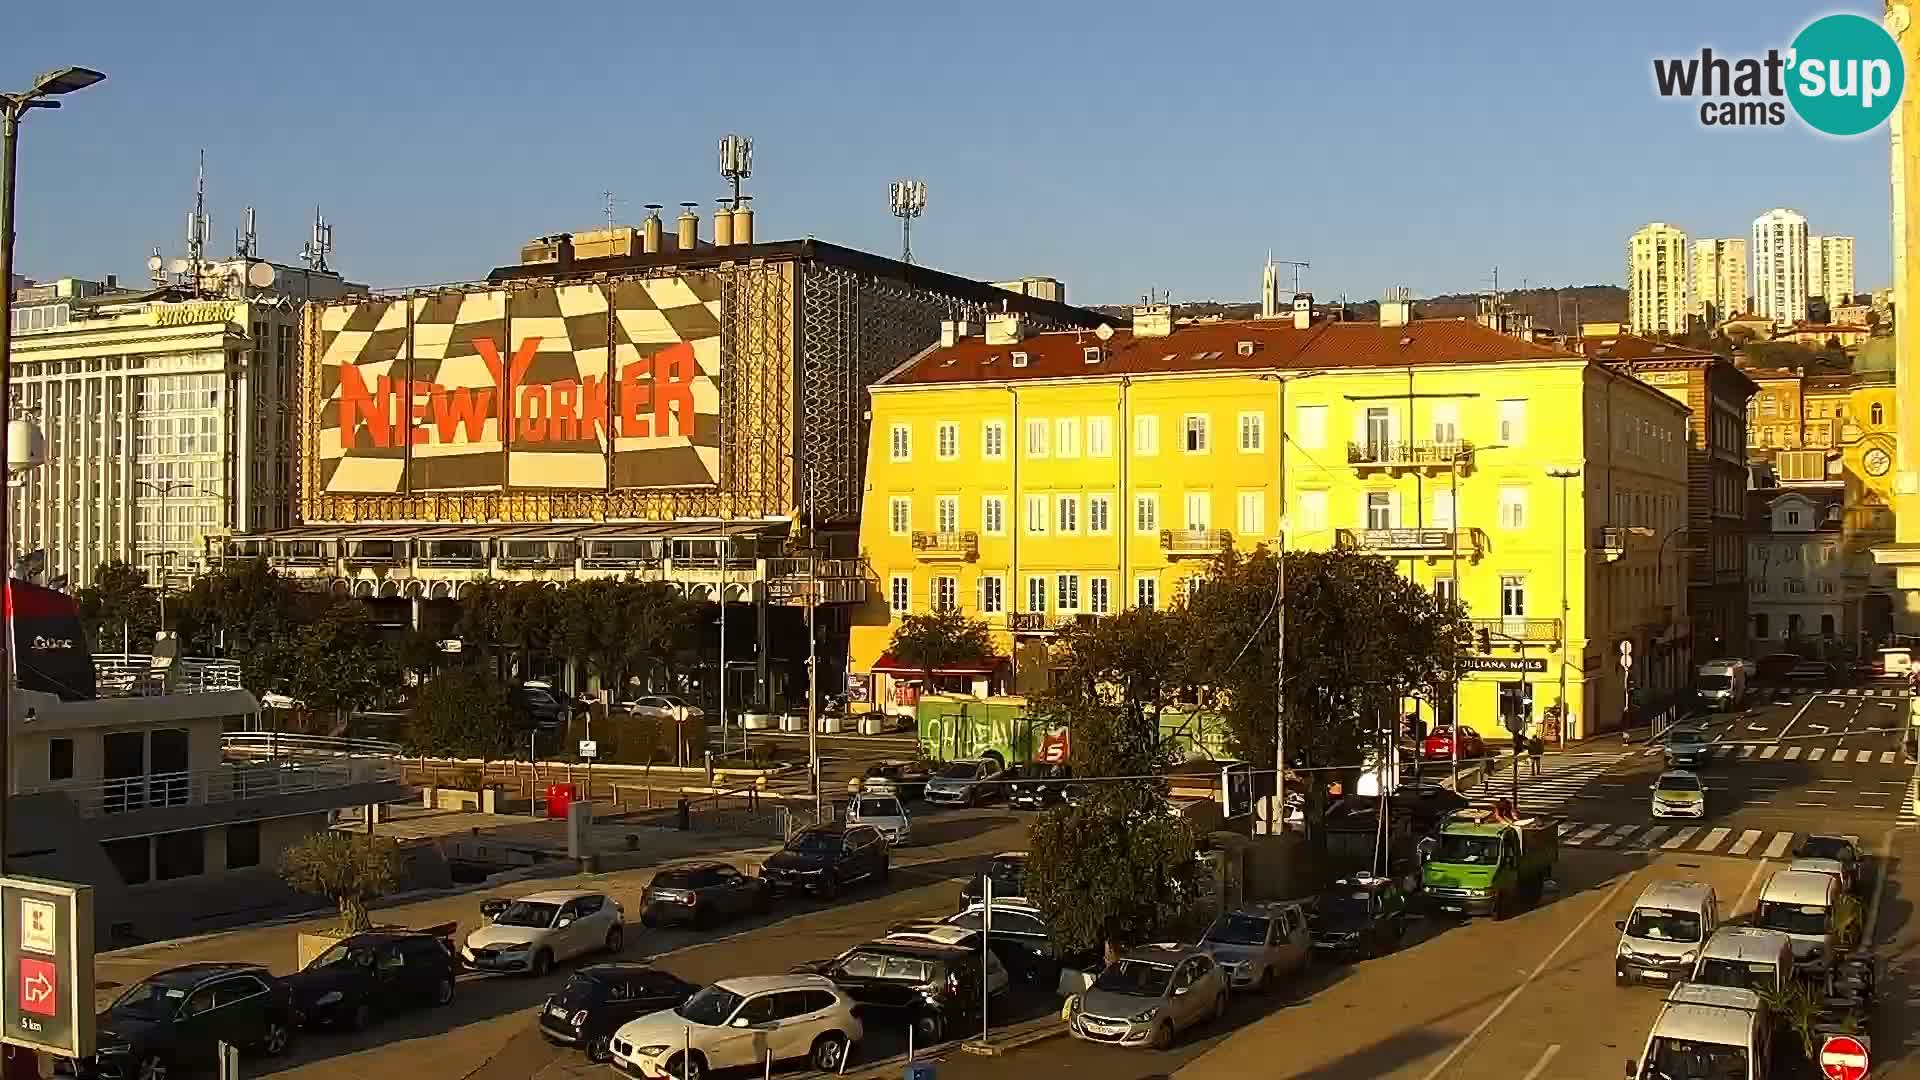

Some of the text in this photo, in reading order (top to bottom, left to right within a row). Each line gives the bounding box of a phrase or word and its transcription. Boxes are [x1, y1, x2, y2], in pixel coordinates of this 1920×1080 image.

[1460, 660, 1543, 669] JULIANA NAILS
[28, 1019, 42, 1032] km
